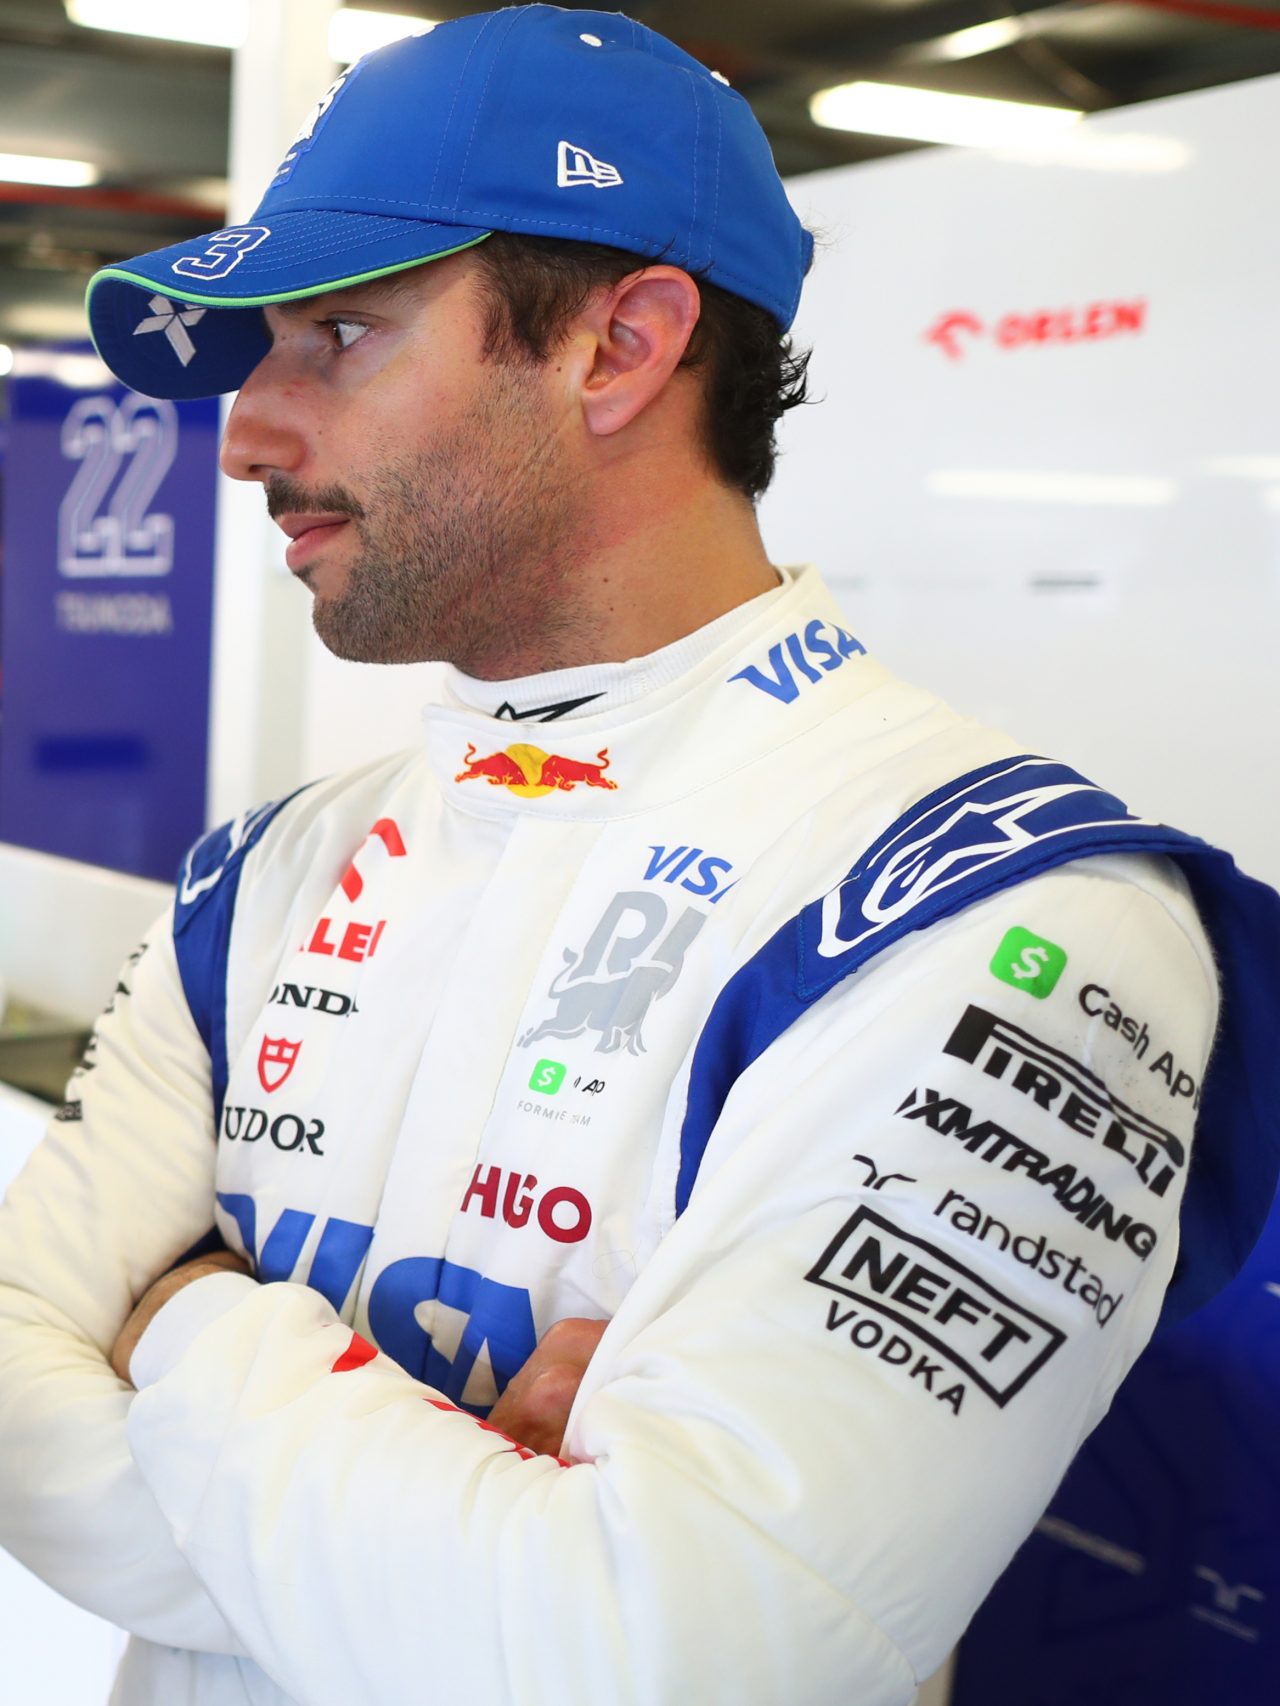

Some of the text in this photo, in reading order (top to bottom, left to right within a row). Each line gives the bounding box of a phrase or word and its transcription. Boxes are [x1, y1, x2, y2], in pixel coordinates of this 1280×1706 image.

[171, 226, 271, 280] 3
[995, 298, 1148, 351] ORLEN
[57, 391, 179, 578] 22
[727, 619, 867, 704] VISA
[942, 1003, 1184, 1198] PIRELLI
[1079, 983, 1150, 1060] Cash
[1149, 1051, 1201, 1111] Ap
[224, 1106, 325, 1156] UDOR
[841, 1236, 1032, 1362] NEFT
[933, 1189, 1123, 1329] randstad
[825, 1299, 967, 1416] VODKA
